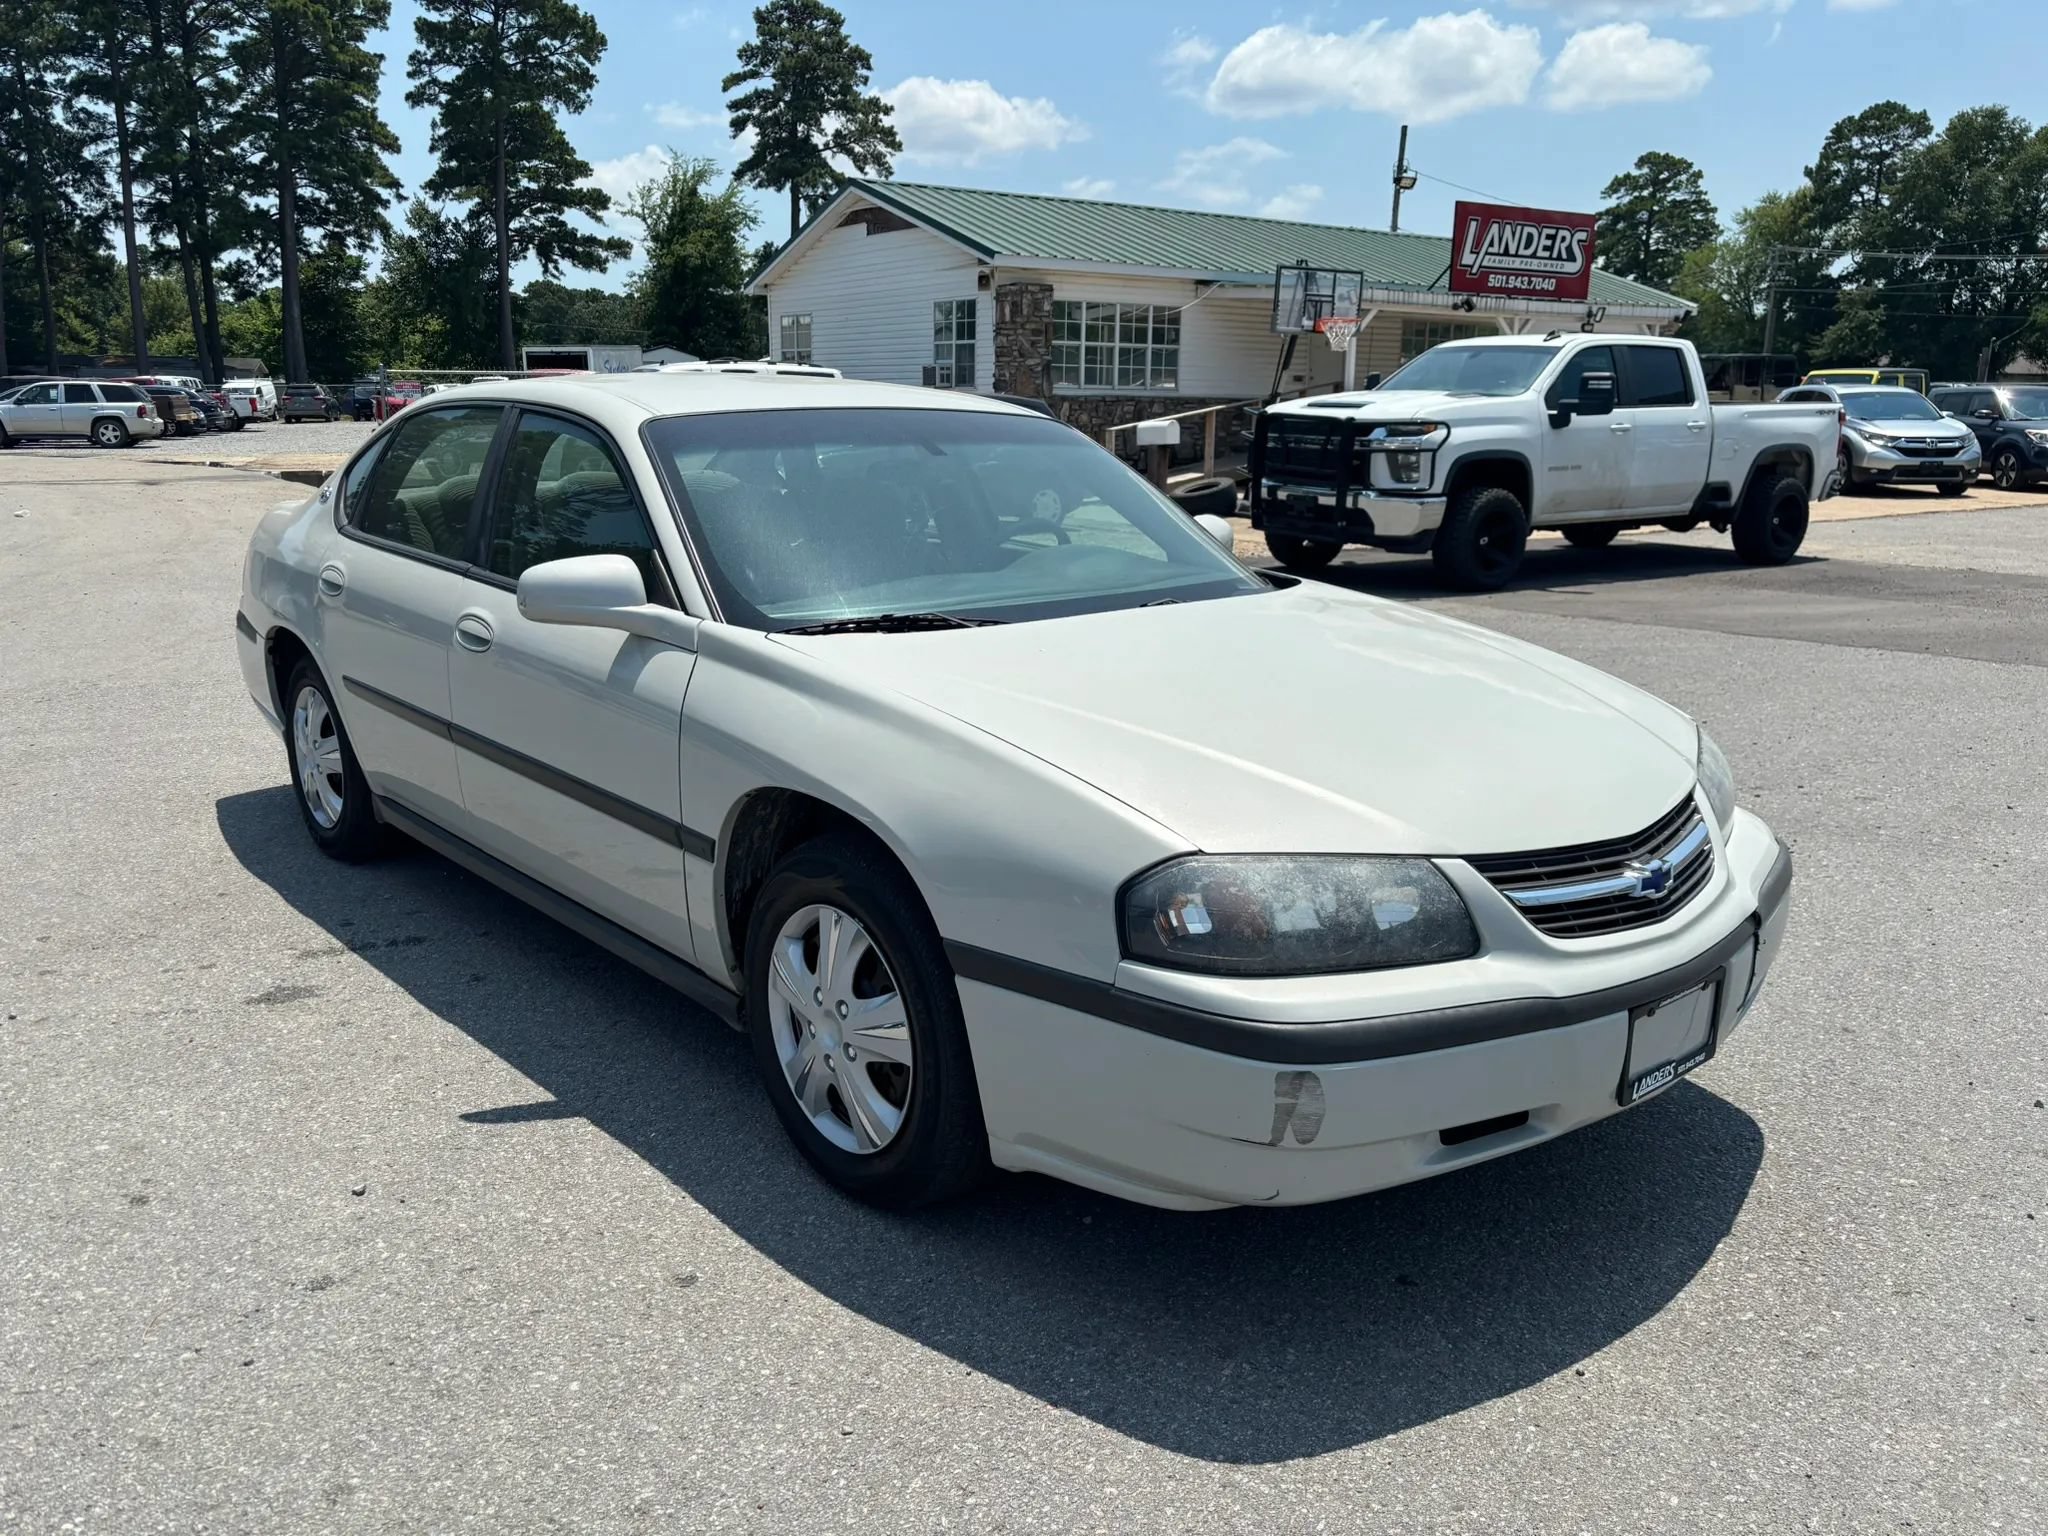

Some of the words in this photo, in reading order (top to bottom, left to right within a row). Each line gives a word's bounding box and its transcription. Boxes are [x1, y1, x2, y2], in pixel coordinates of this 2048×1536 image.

[1459, 219, 1589, 276] LANDERS
[1487, 257, 1516, 267] FAMILY
[1487, 274, 1557, 291] 501.943.7040
[1632, 1061, 1676, 1102] LANDERS
